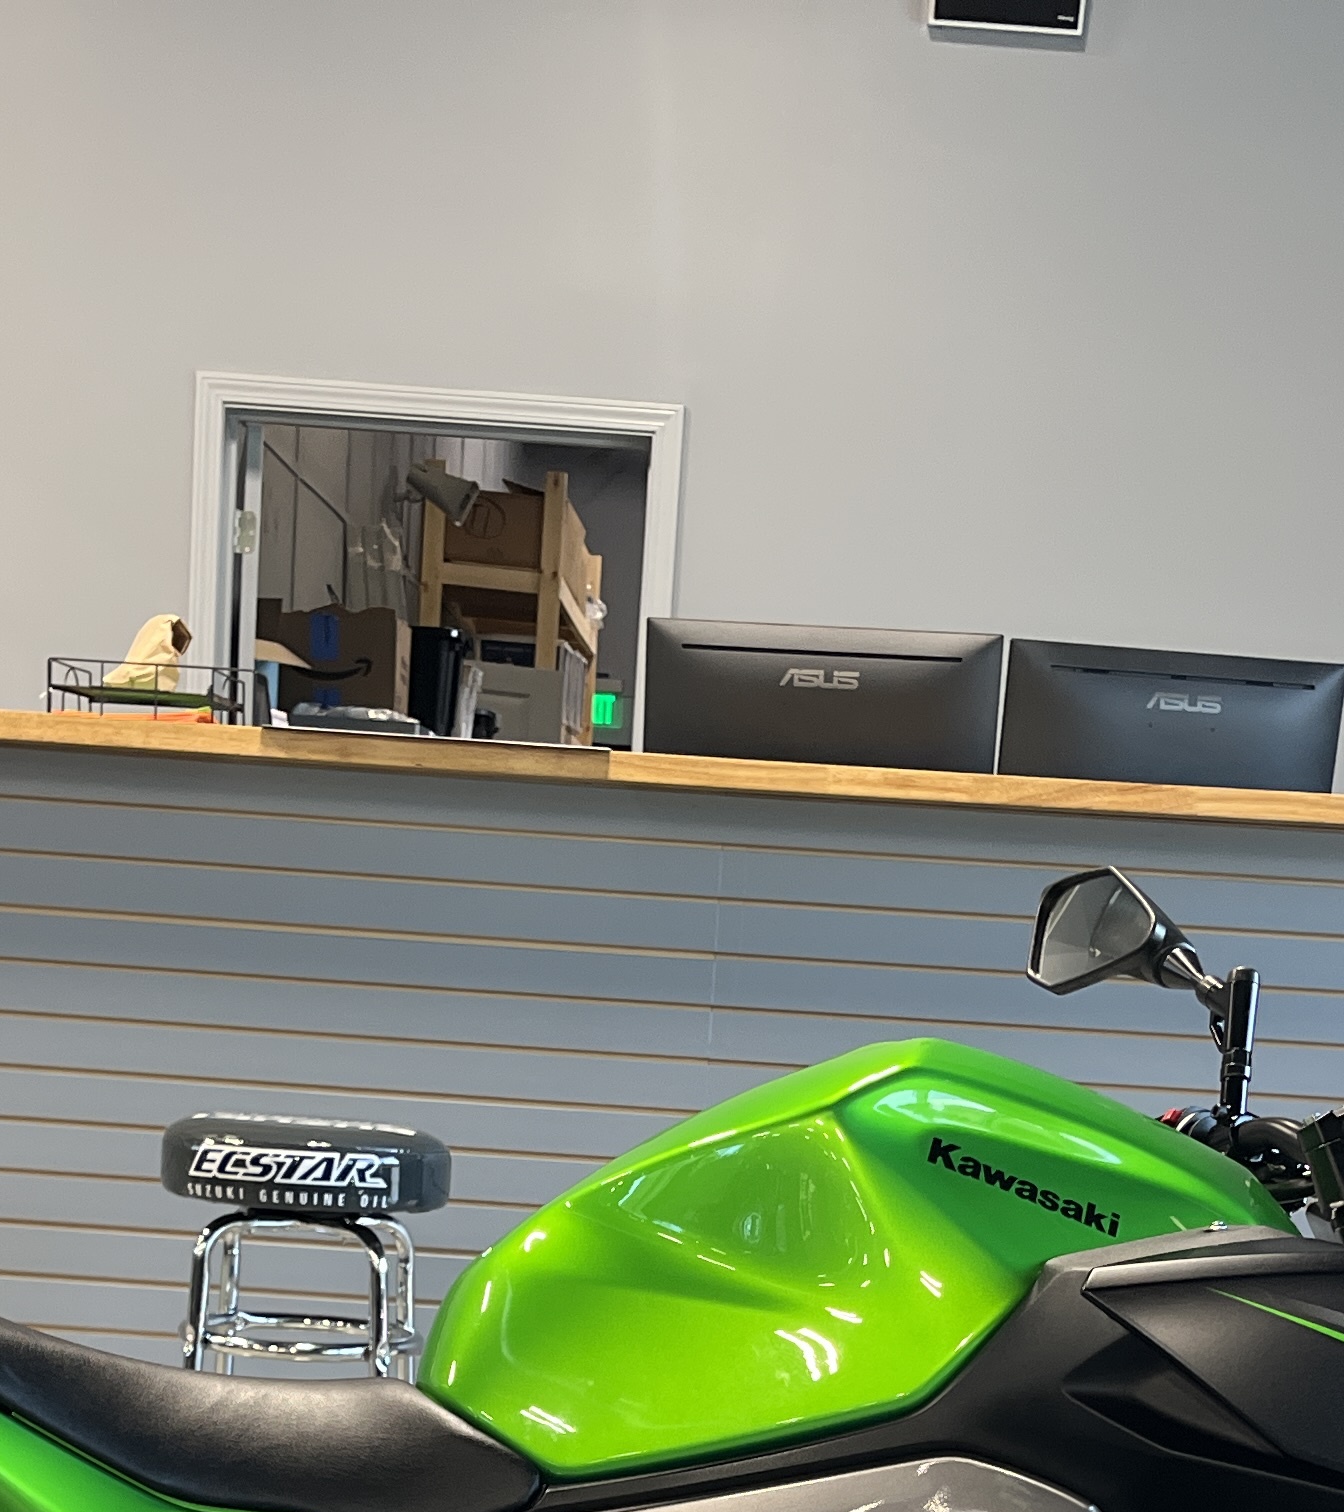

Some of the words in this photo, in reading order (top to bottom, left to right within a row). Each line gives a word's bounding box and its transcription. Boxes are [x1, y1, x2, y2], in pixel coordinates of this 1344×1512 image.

[779, 667, 860, 690] ASUS
[1145, 691, 1223, 715] ASUS
[188, 1142, 388, 1189] ECSTAR
[187, 1182, 245, 1200] SUZUKI
[259, 1191, 346, 1207] GENUINE
[359, 1196, 389, 1209] OIL
[928, 1138, 1122, 1238] Kawasaki
